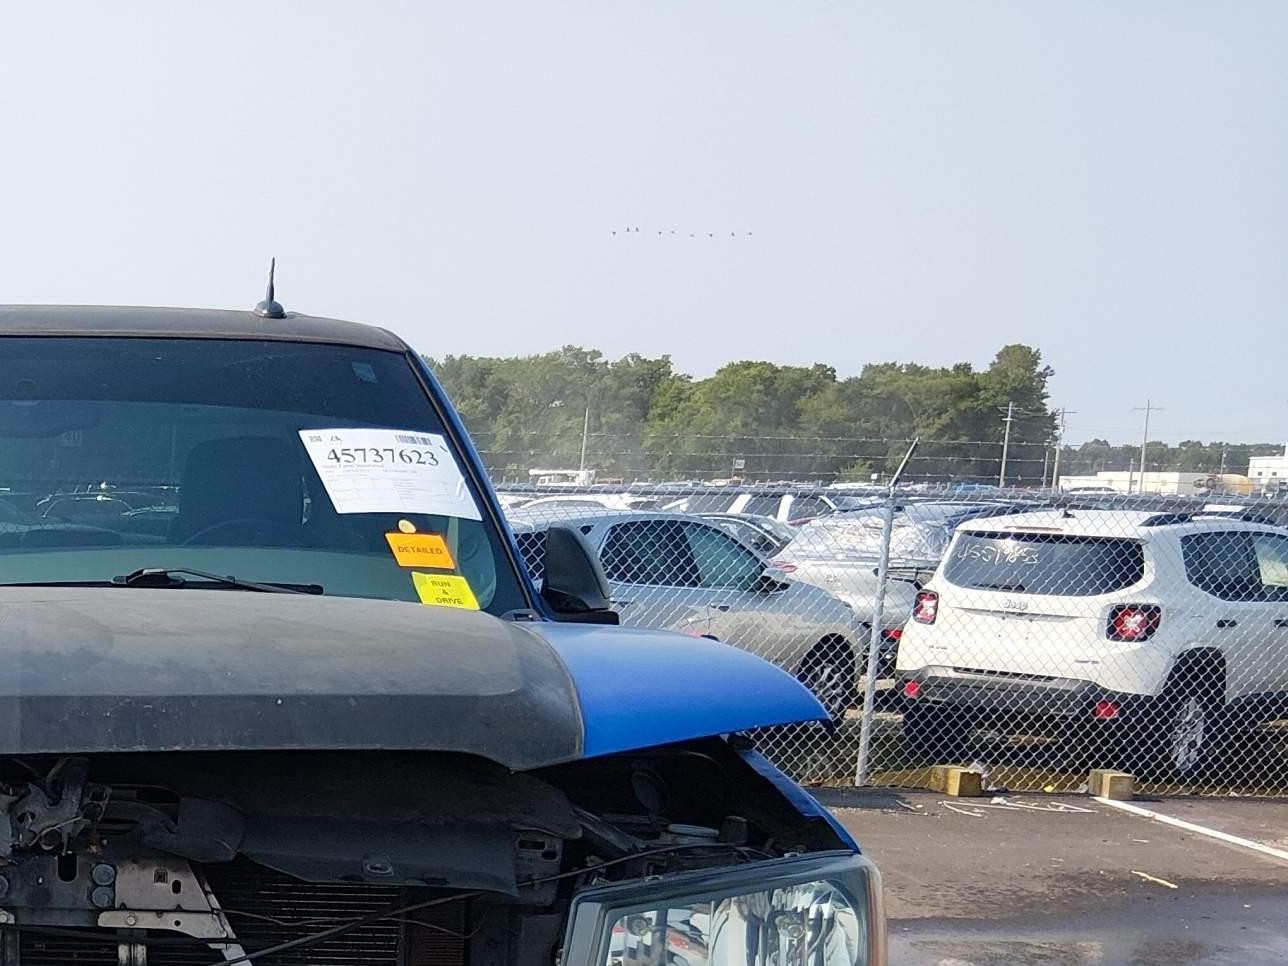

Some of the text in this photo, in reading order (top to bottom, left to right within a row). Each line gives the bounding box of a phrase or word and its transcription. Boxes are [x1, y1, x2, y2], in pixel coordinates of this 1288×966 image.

[327, 448, 440, 467] 45737623
[397, 546, 444, 555] DETAILED
[431, 580, 452, 588] RUN
[435, 597, 464, 605] DRIVE
